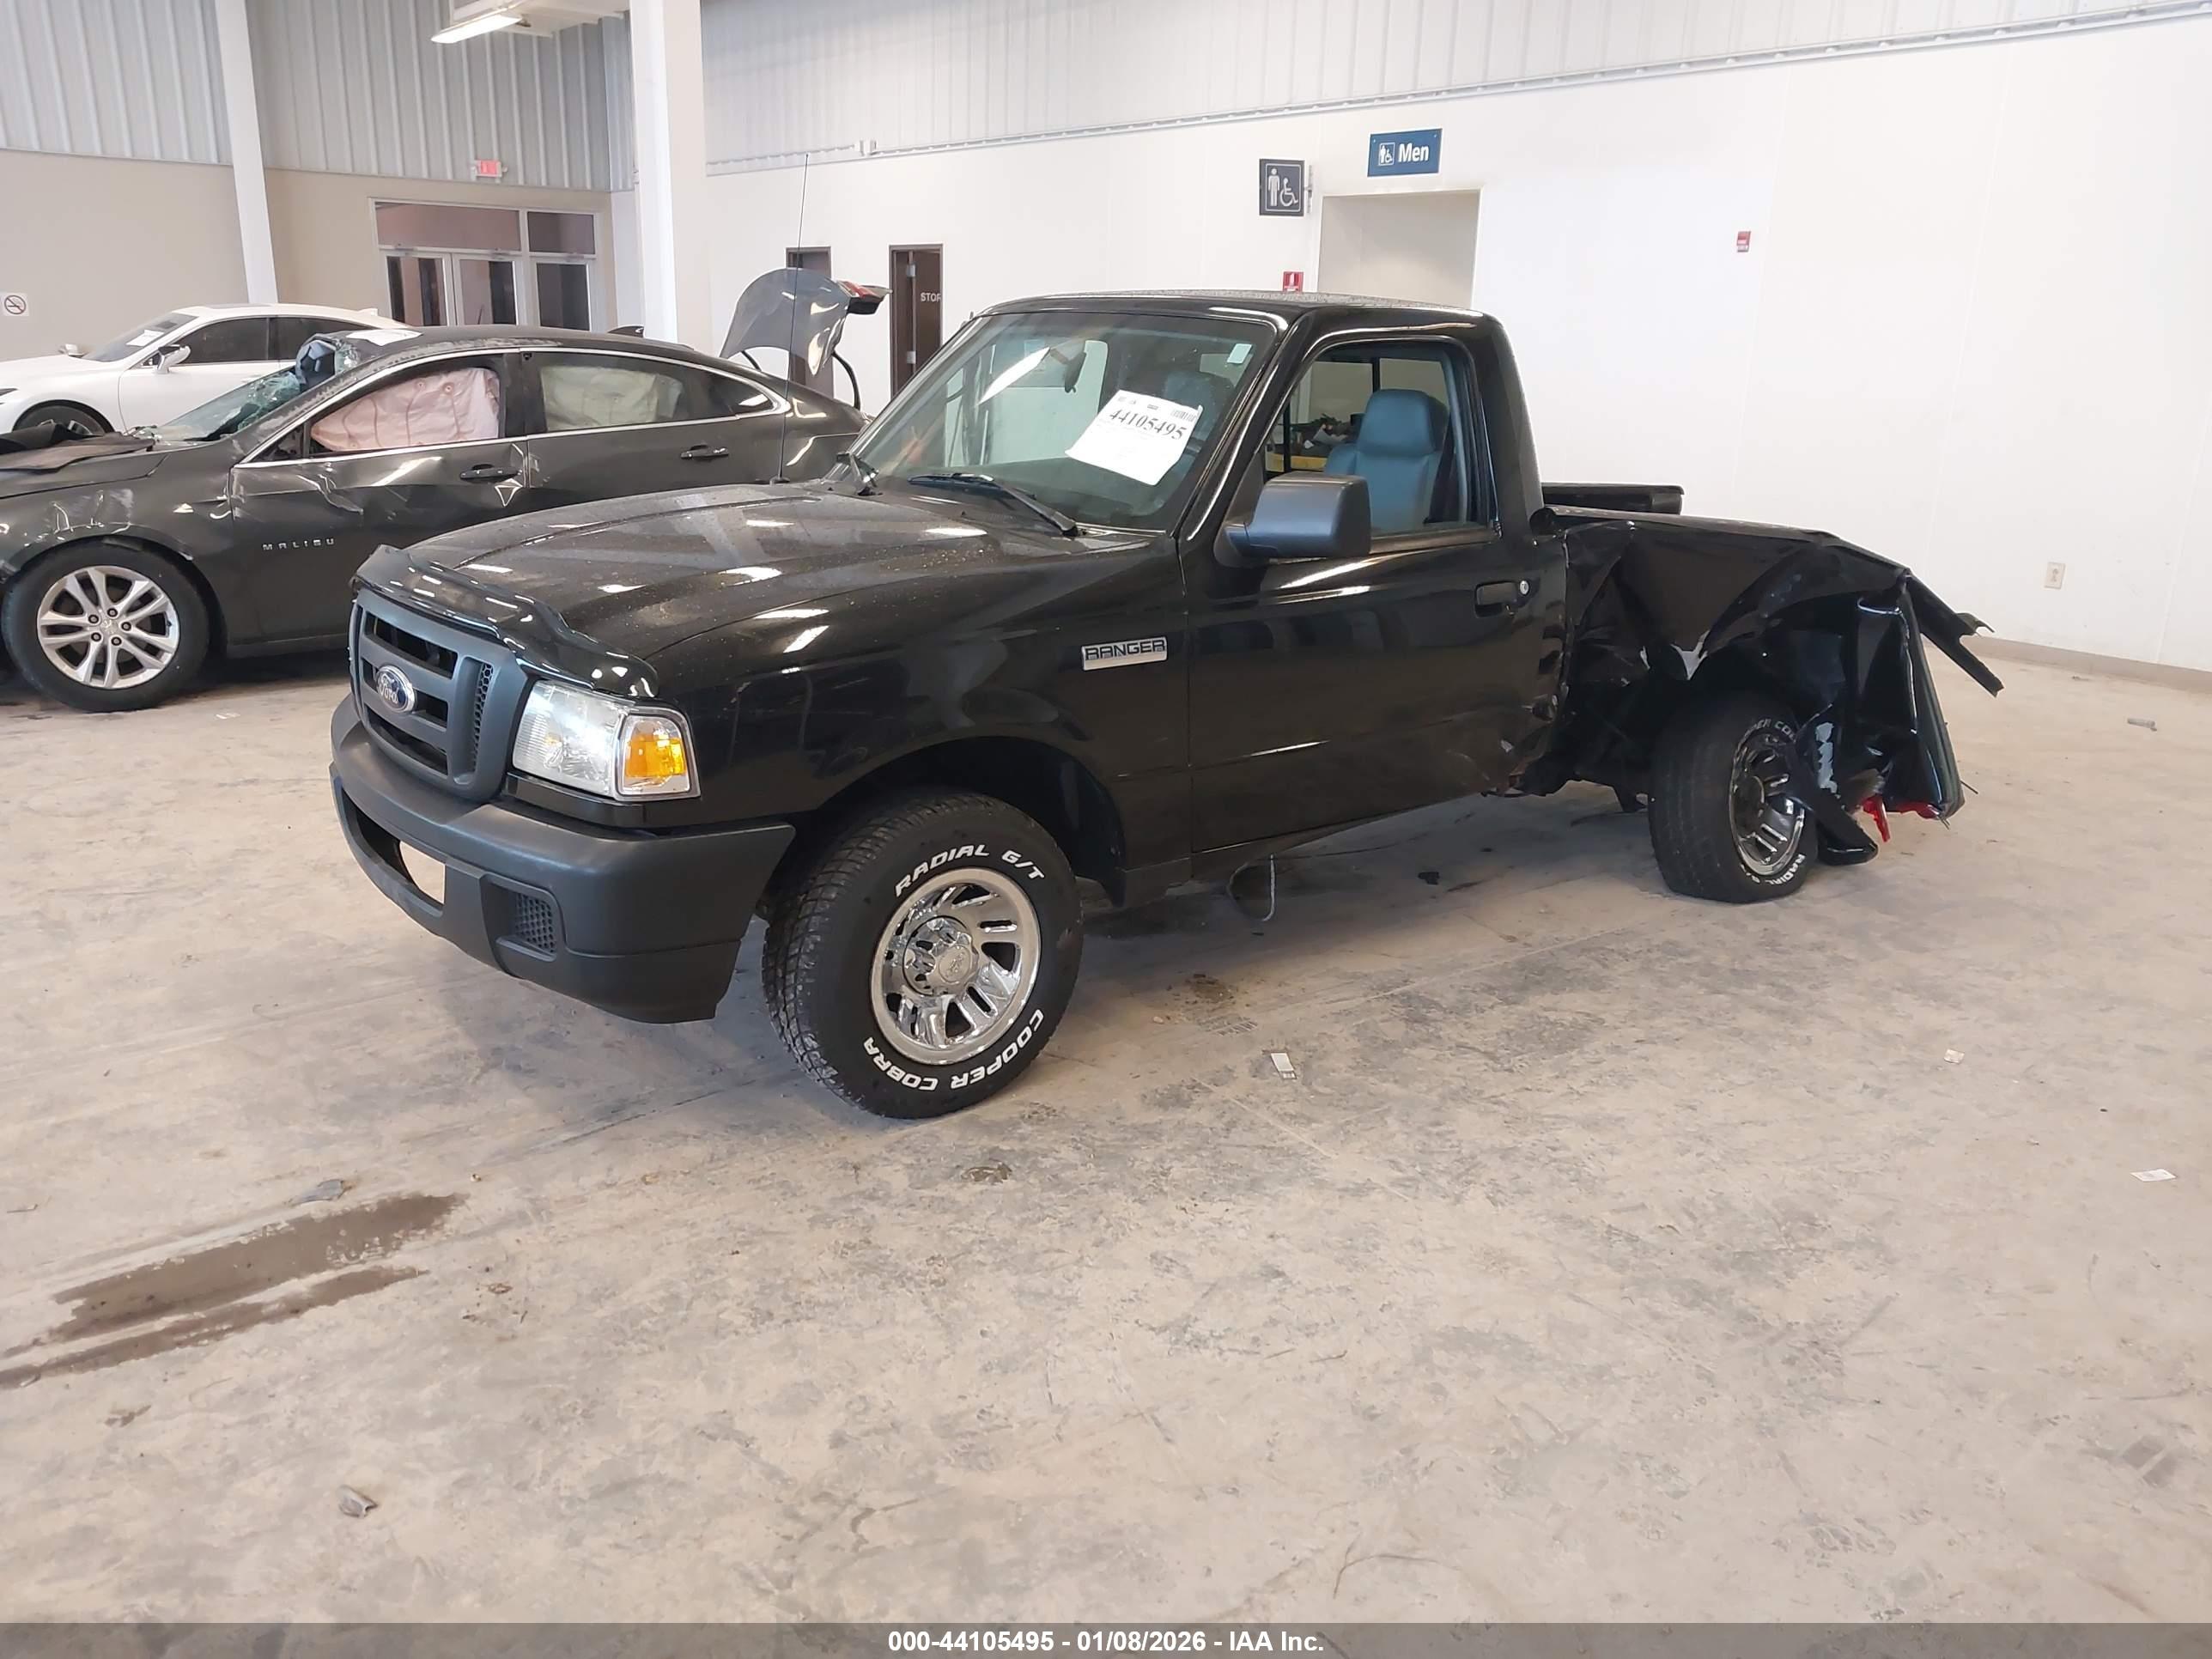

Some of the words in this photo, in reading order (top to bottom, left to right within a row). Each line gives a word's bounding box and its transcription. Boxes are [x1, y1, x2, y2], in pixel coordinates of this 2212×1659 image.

[1398, 143, 1430, 163] Men
[1109, 409, 1188, 440] 44105495
[262, 538, 334, 550] MALIBU
[1085, 639, 1166, 660] RANGER
[895, 843, 990, 897] RADIAL
[1001, 849, 1045, 880] G/T
[863, 1036, 939, 1091] COBRA
[951, 1009, 1044, 1090] COOPER
